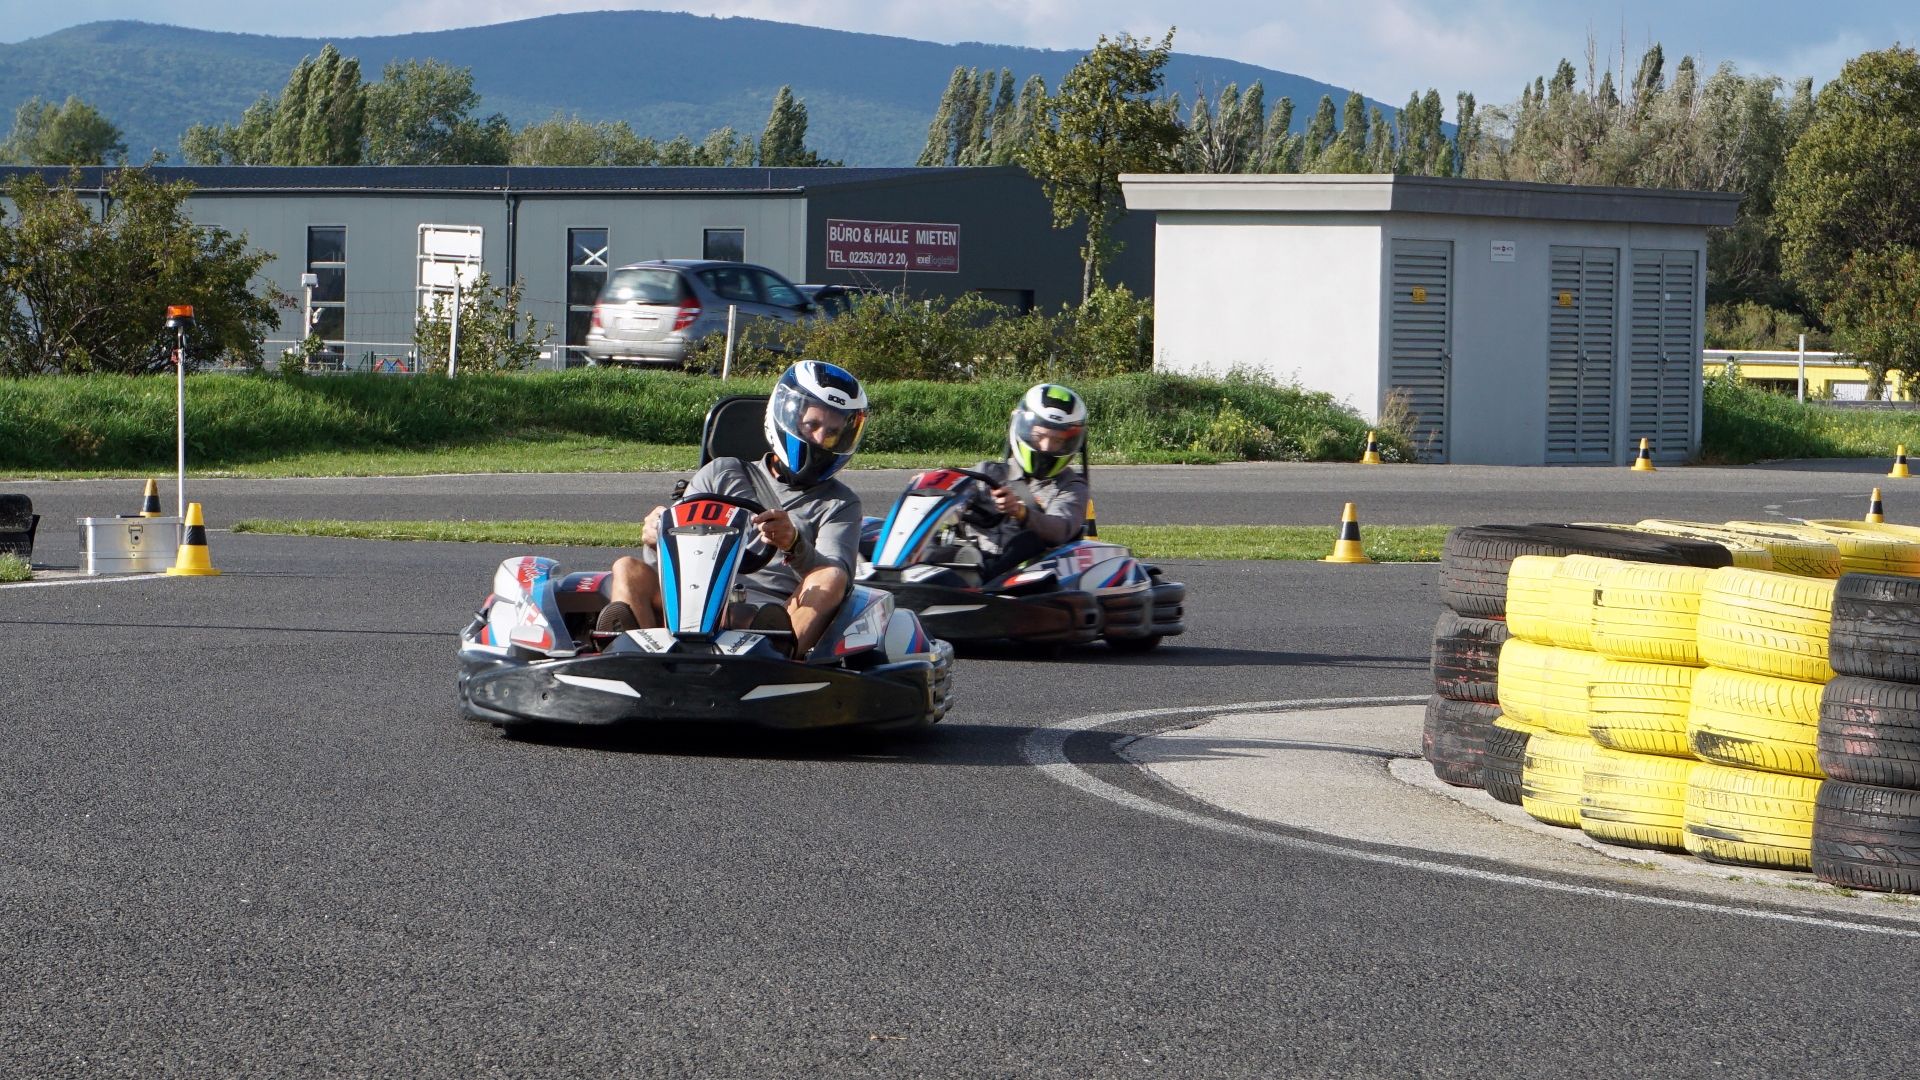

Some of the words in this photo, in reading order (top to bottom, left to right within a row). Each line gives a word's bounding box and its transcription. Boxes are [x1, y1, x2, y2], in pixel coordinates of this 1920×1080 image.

[830, 224, 861, 242] BÜRO
[863, 228, 872, 243] &
[875, 229, 908, 244] HALLE
[916, 230, 956, 245] MIETEN
[686, 503, 723, 522] 10
